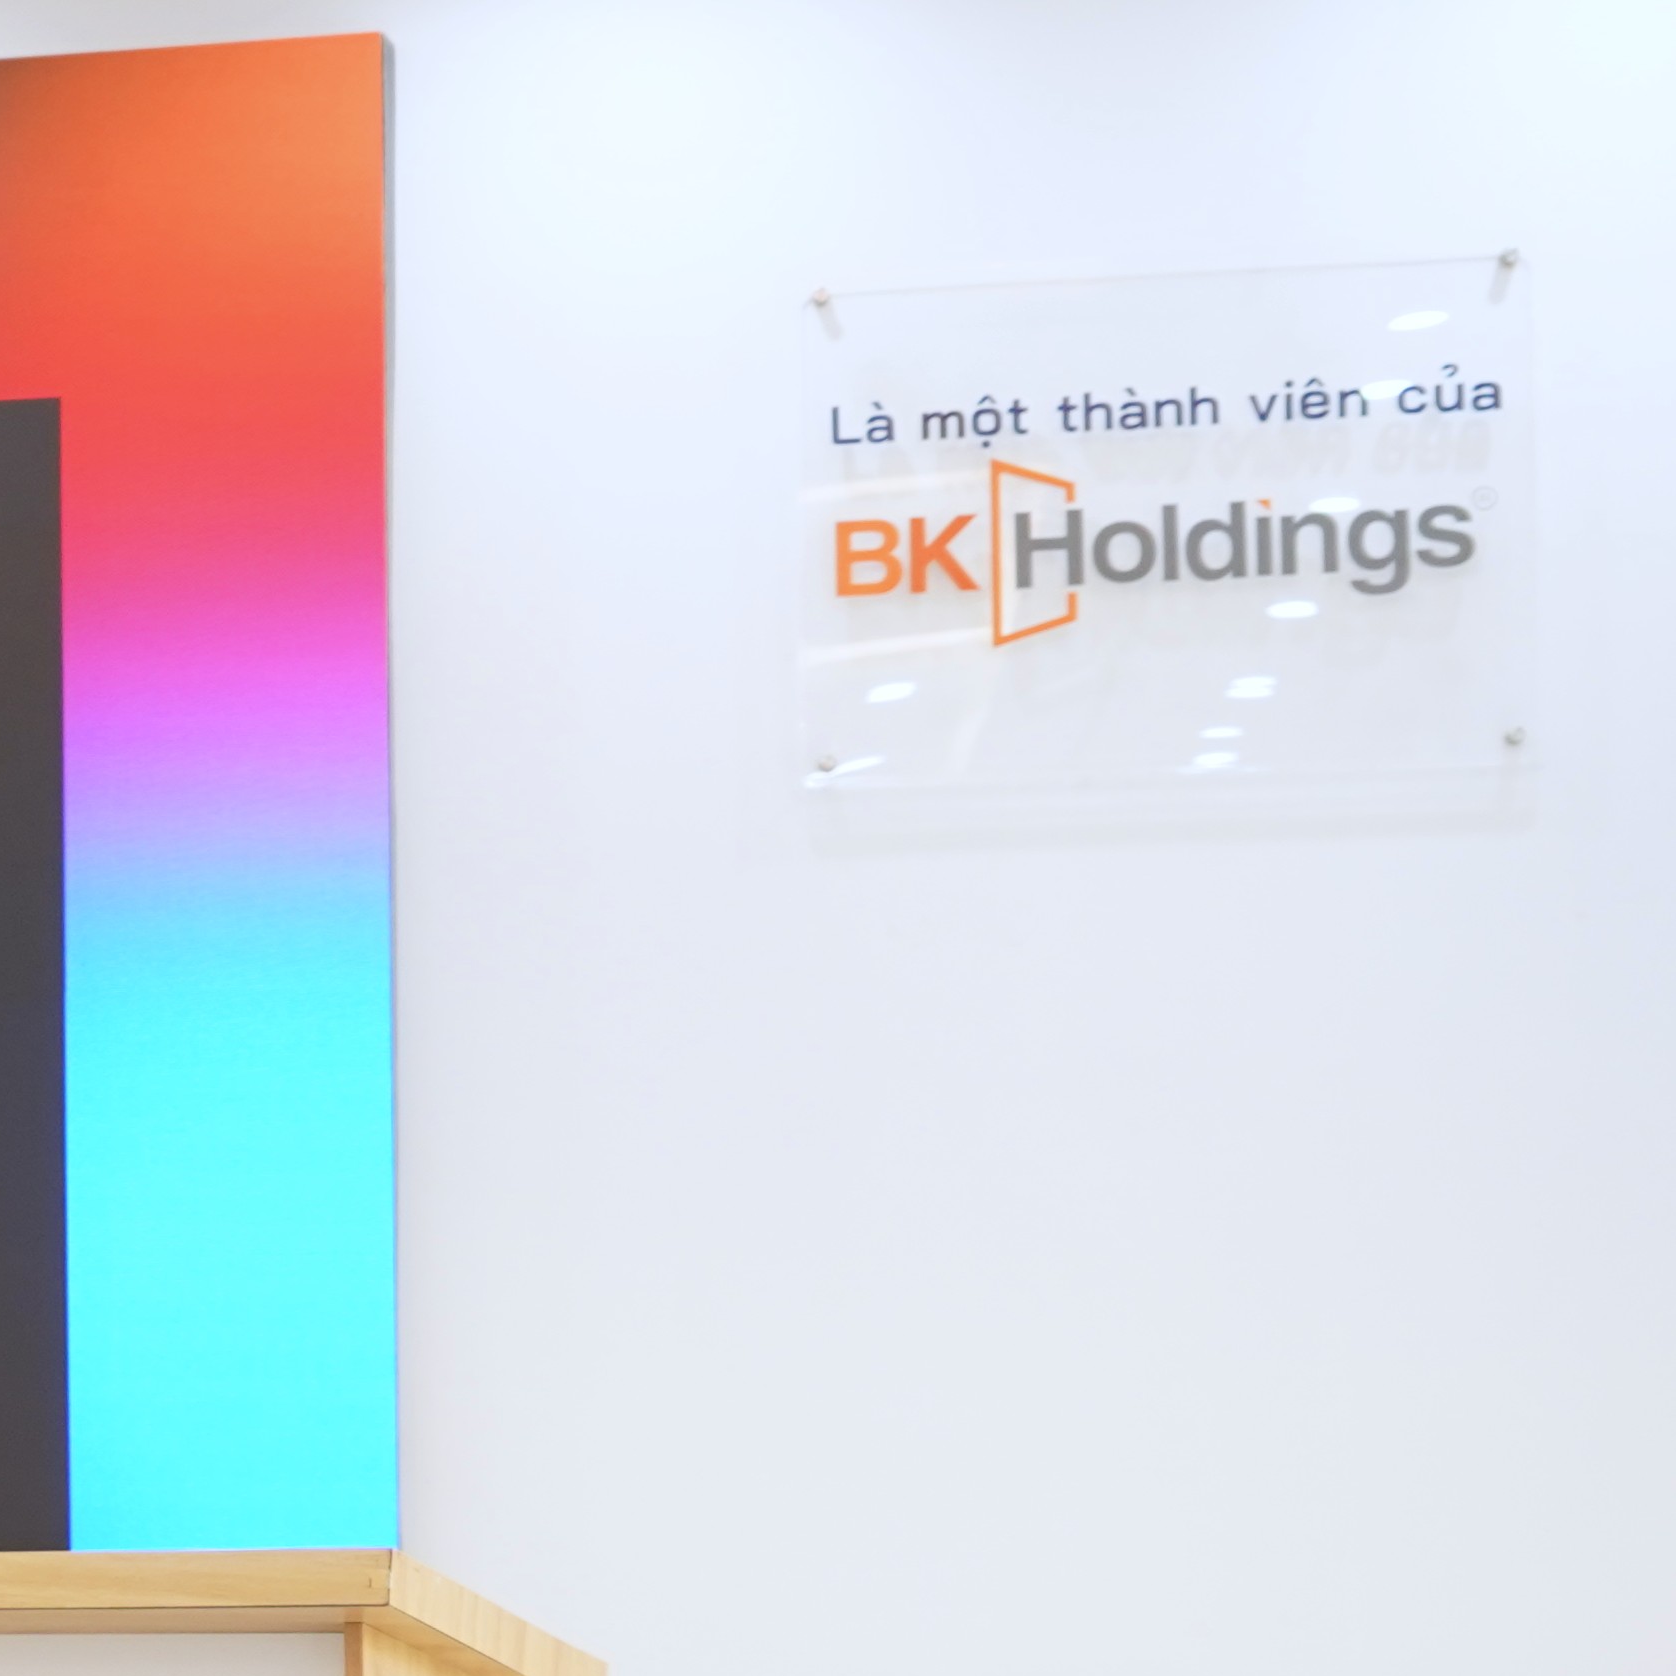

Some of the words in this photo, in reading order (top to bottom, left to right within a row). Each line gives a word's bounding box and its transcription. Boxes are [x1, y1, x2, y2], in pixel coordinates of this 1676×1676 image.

[830, 400, 895, 447] Là
[921, 398, 1029, 449] một
[1058, 387, 1221, 435] thành
[1249, 378, 1369, 423] viên
[1396, 363, 1502, 414] của
[835, 514, 980, 598] BK
[1014, 498, 1477, 596] Holdings
